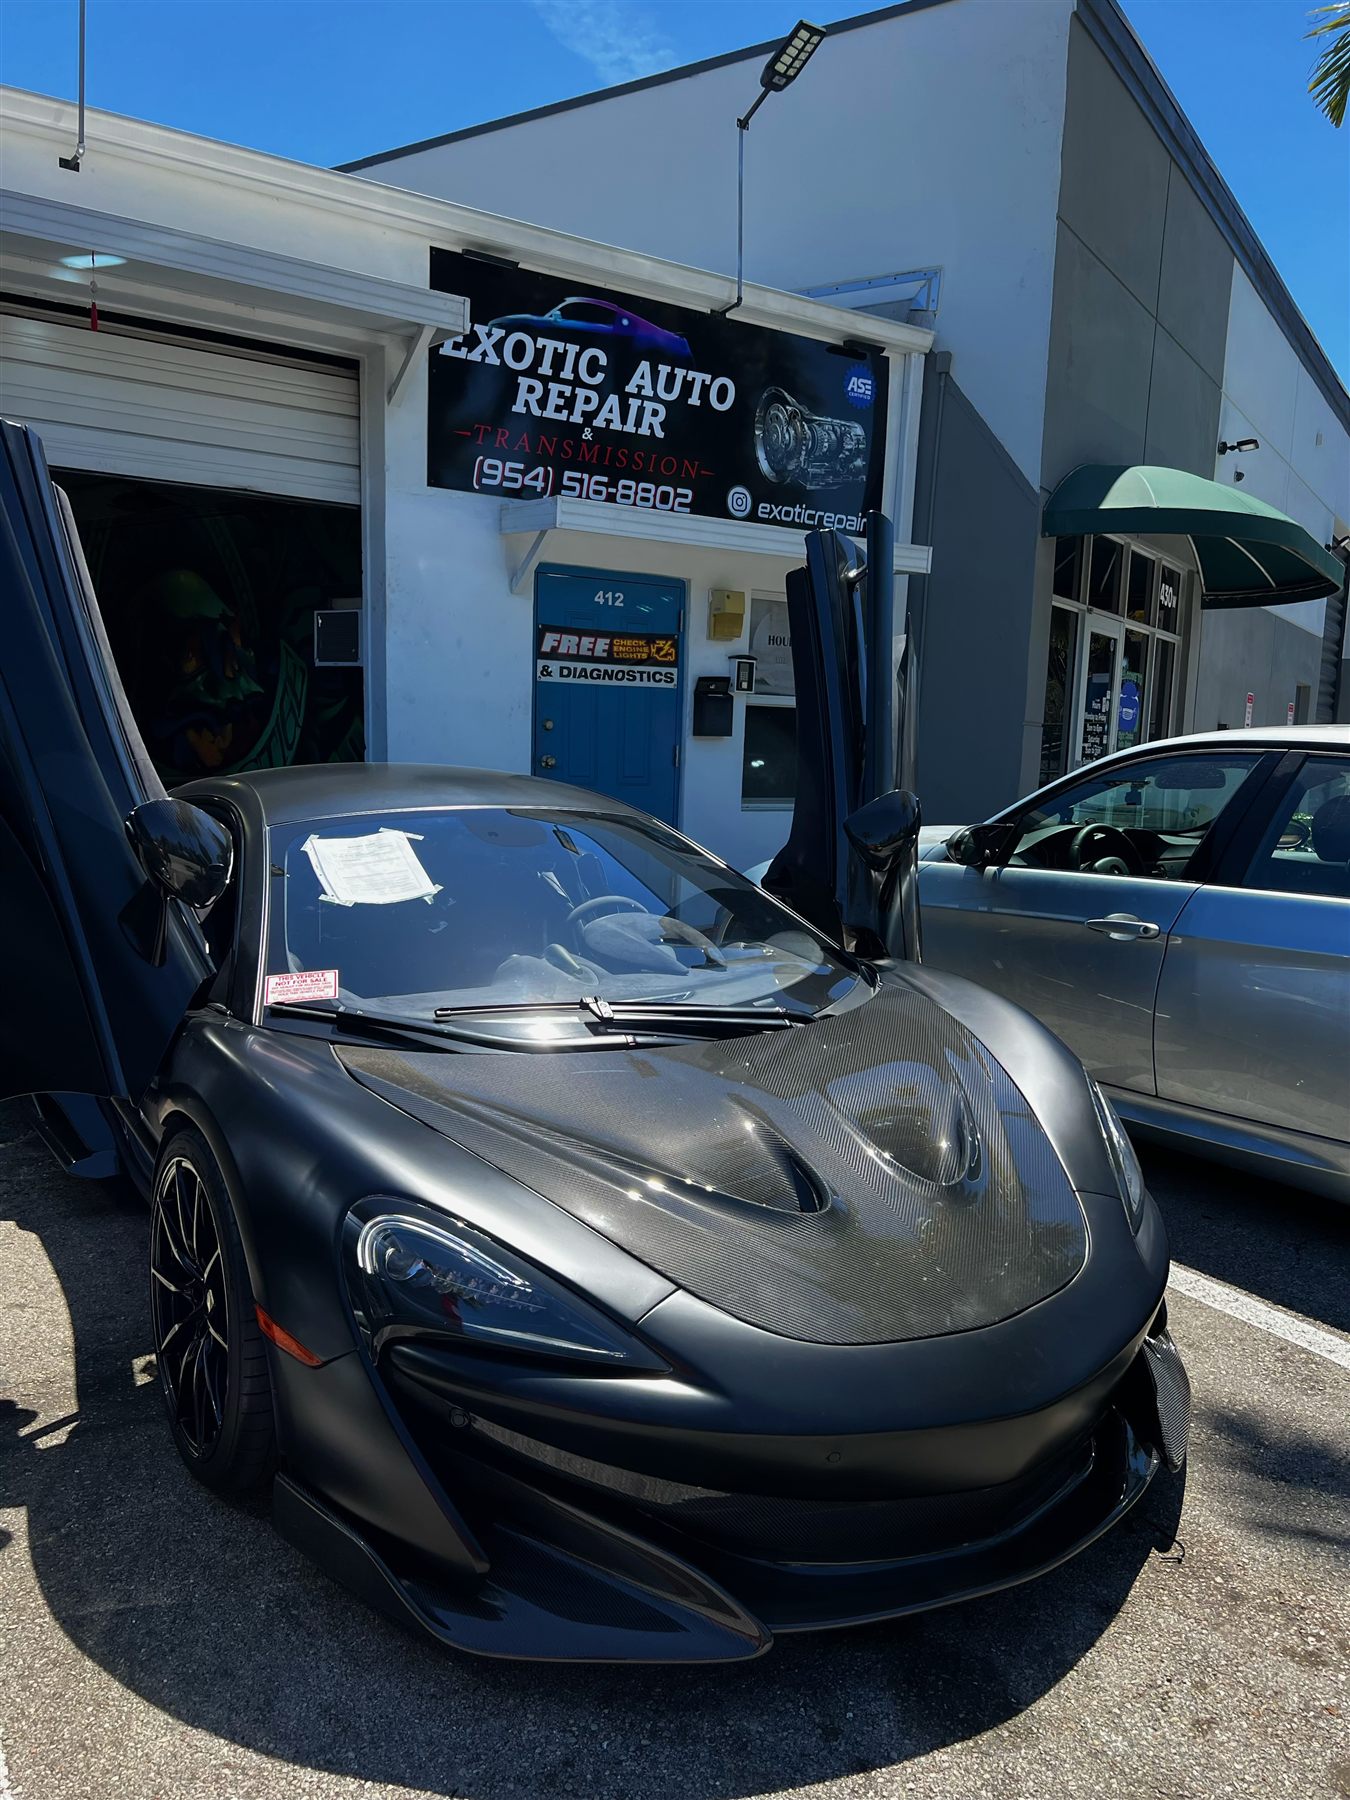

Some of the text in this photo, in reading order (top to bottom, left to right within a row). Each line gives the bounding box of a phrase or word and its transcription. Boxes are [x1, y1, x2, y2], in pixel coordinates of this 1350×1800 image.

[624, 360, 736, 412] AUTO
[847, 376, 872, 395] ASE
[511, 376, 667, 439] REPAIR
[582, 427, 594, 441] &
[473, 424, 702, 479] TRANSMISSION
[473, 455, 694, 513] (954) 516-8802
[593, 590, 625, 607] 412
[541, 632, 611, 658] FREE
[613, 639, 647, 647] CHECK
[613, 645, 649, 653] ENGINE
[768, 635, 792, 649] HOU
[540, 664, 675, 684] & DIAGNOSTICS
